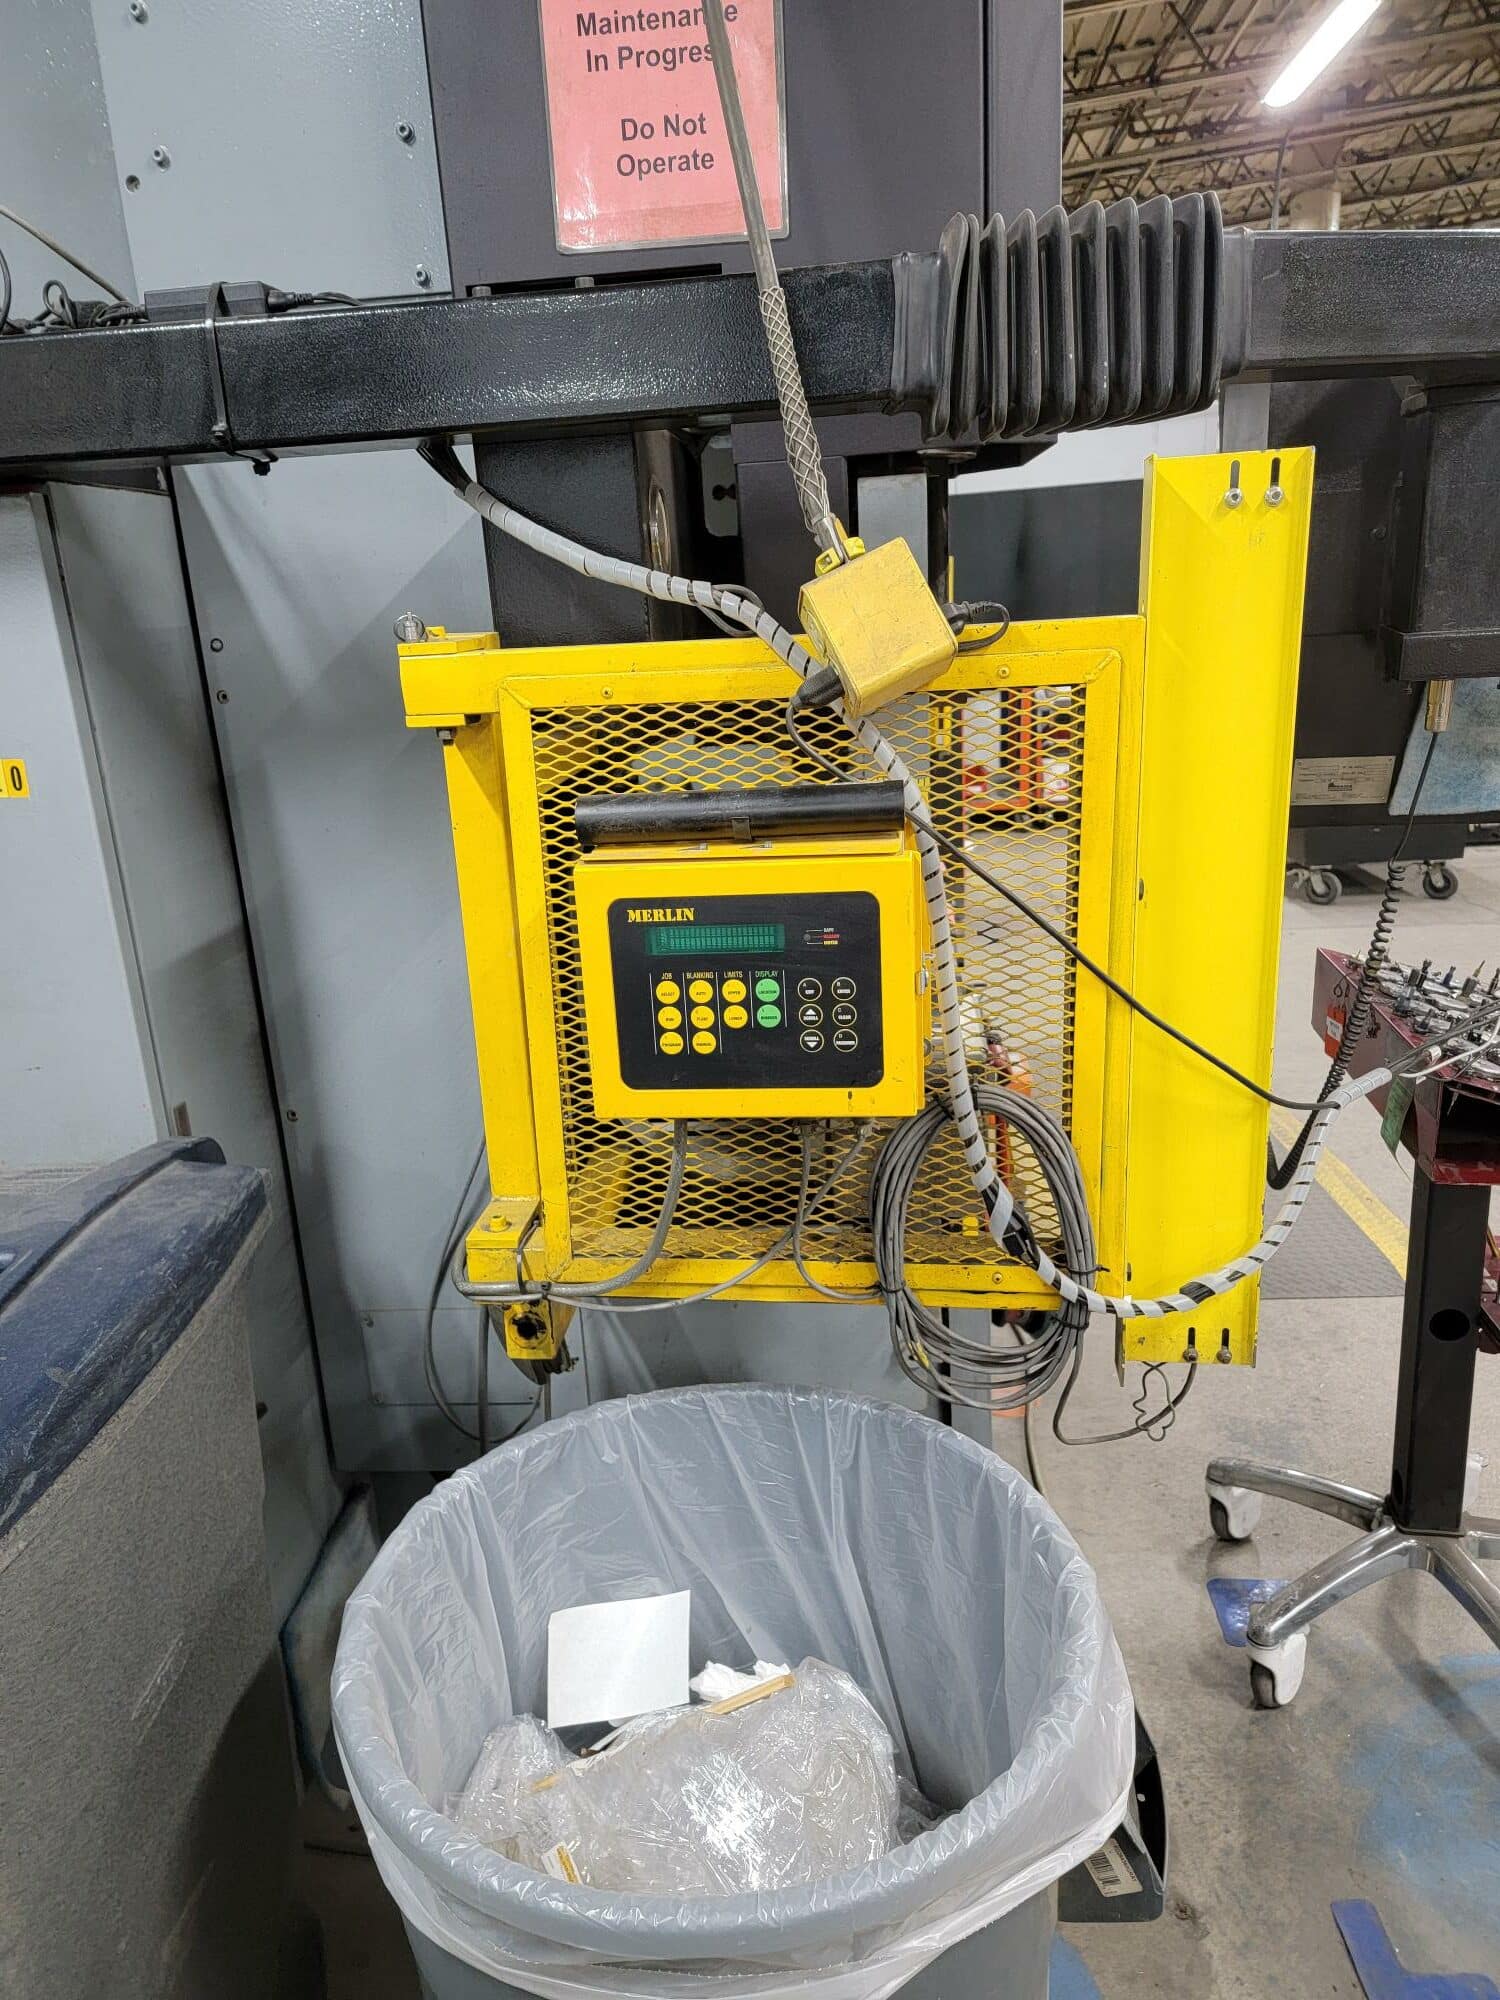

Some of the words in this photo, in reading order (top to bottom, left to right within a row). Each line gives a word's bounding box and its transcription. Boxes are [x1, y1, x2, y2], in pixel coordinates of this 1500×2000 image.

[576, 4, 739, 37] Maintenane
[586, 49, 609, 73] In
[617, 44, 715, 72] Progres
[620, 117, 655, 141] Do
[663, 112, 707, 138] Not
[616, 149, 715, 181] Operate
[627, 907, 695, 923] MERLIN
[661, 972, 673, 980] JOB
[686, 971, 714, 980] BLANKING
[723, 971, 743, 979] LIMITS
[755, 970, 779, 978] DISPLAY
